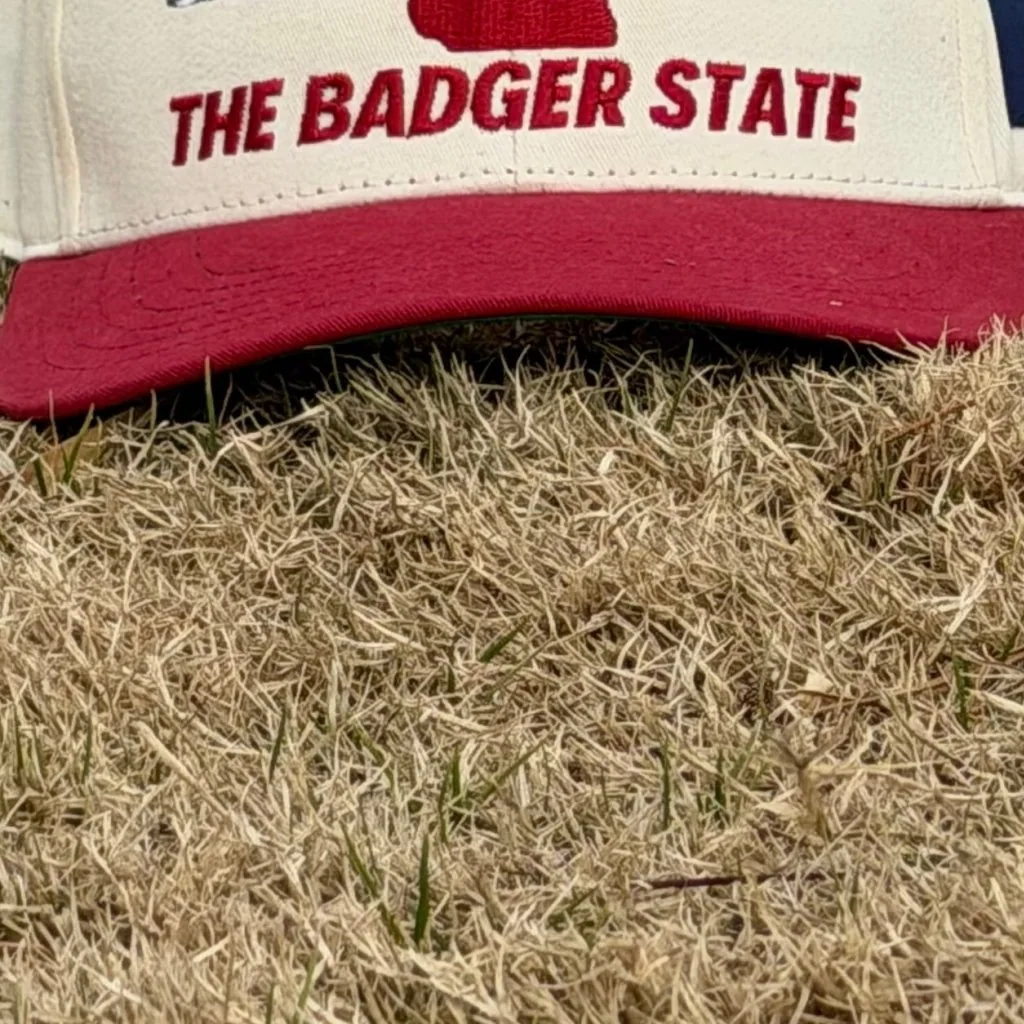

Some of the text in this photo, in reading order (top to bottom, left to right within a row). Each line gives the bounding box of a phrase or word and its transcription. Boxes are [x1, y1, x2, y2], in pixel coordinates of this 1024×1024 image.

[170, 56, 862, 166] THE BADGER STATE
